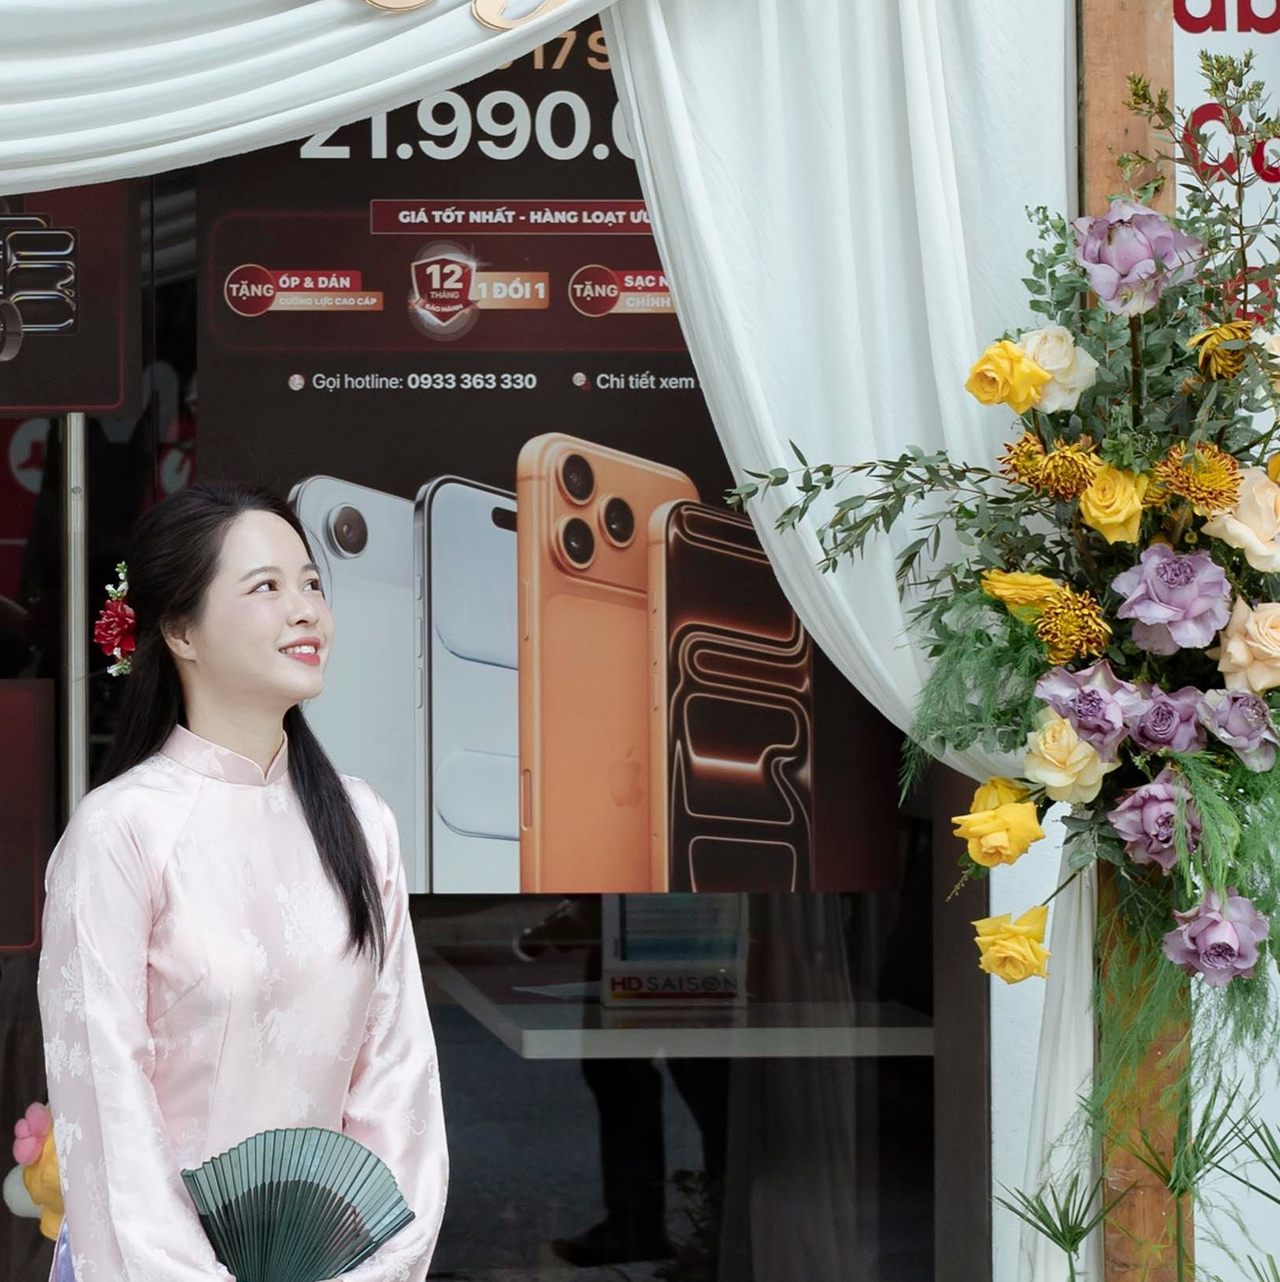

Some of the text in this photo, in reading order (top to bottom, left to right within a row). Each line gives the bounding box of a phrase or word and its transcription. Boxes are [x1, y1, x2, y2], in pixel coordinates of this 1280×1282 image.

[398, 207, 429, 224] GIÁ
[431, 206, 465, 224] TỐT
[469, 206, 516, 224] NHẤT
[529, 207, 578, 224] HÀNG
[582, 210, 626, 227] LOẠT
[278, 273, 351, 289] ỐP & DÁN
[425, 263, 463, 289] 12
[624, 275, 656, 290] SẠC
[228, 280, 275, 300] TẶNG
[477, 277, 545, 299] 1 ĐỔI 1
[572, 280, 619, 301] TẶNG
[335, 297, 356, 306] CAO
[312, 373, 537, 393] Gọi hotline: 0933 363 330
[596, 370, 695, 389] Chi tiết xem
[611, 976, 738, 992] HD SAISON
